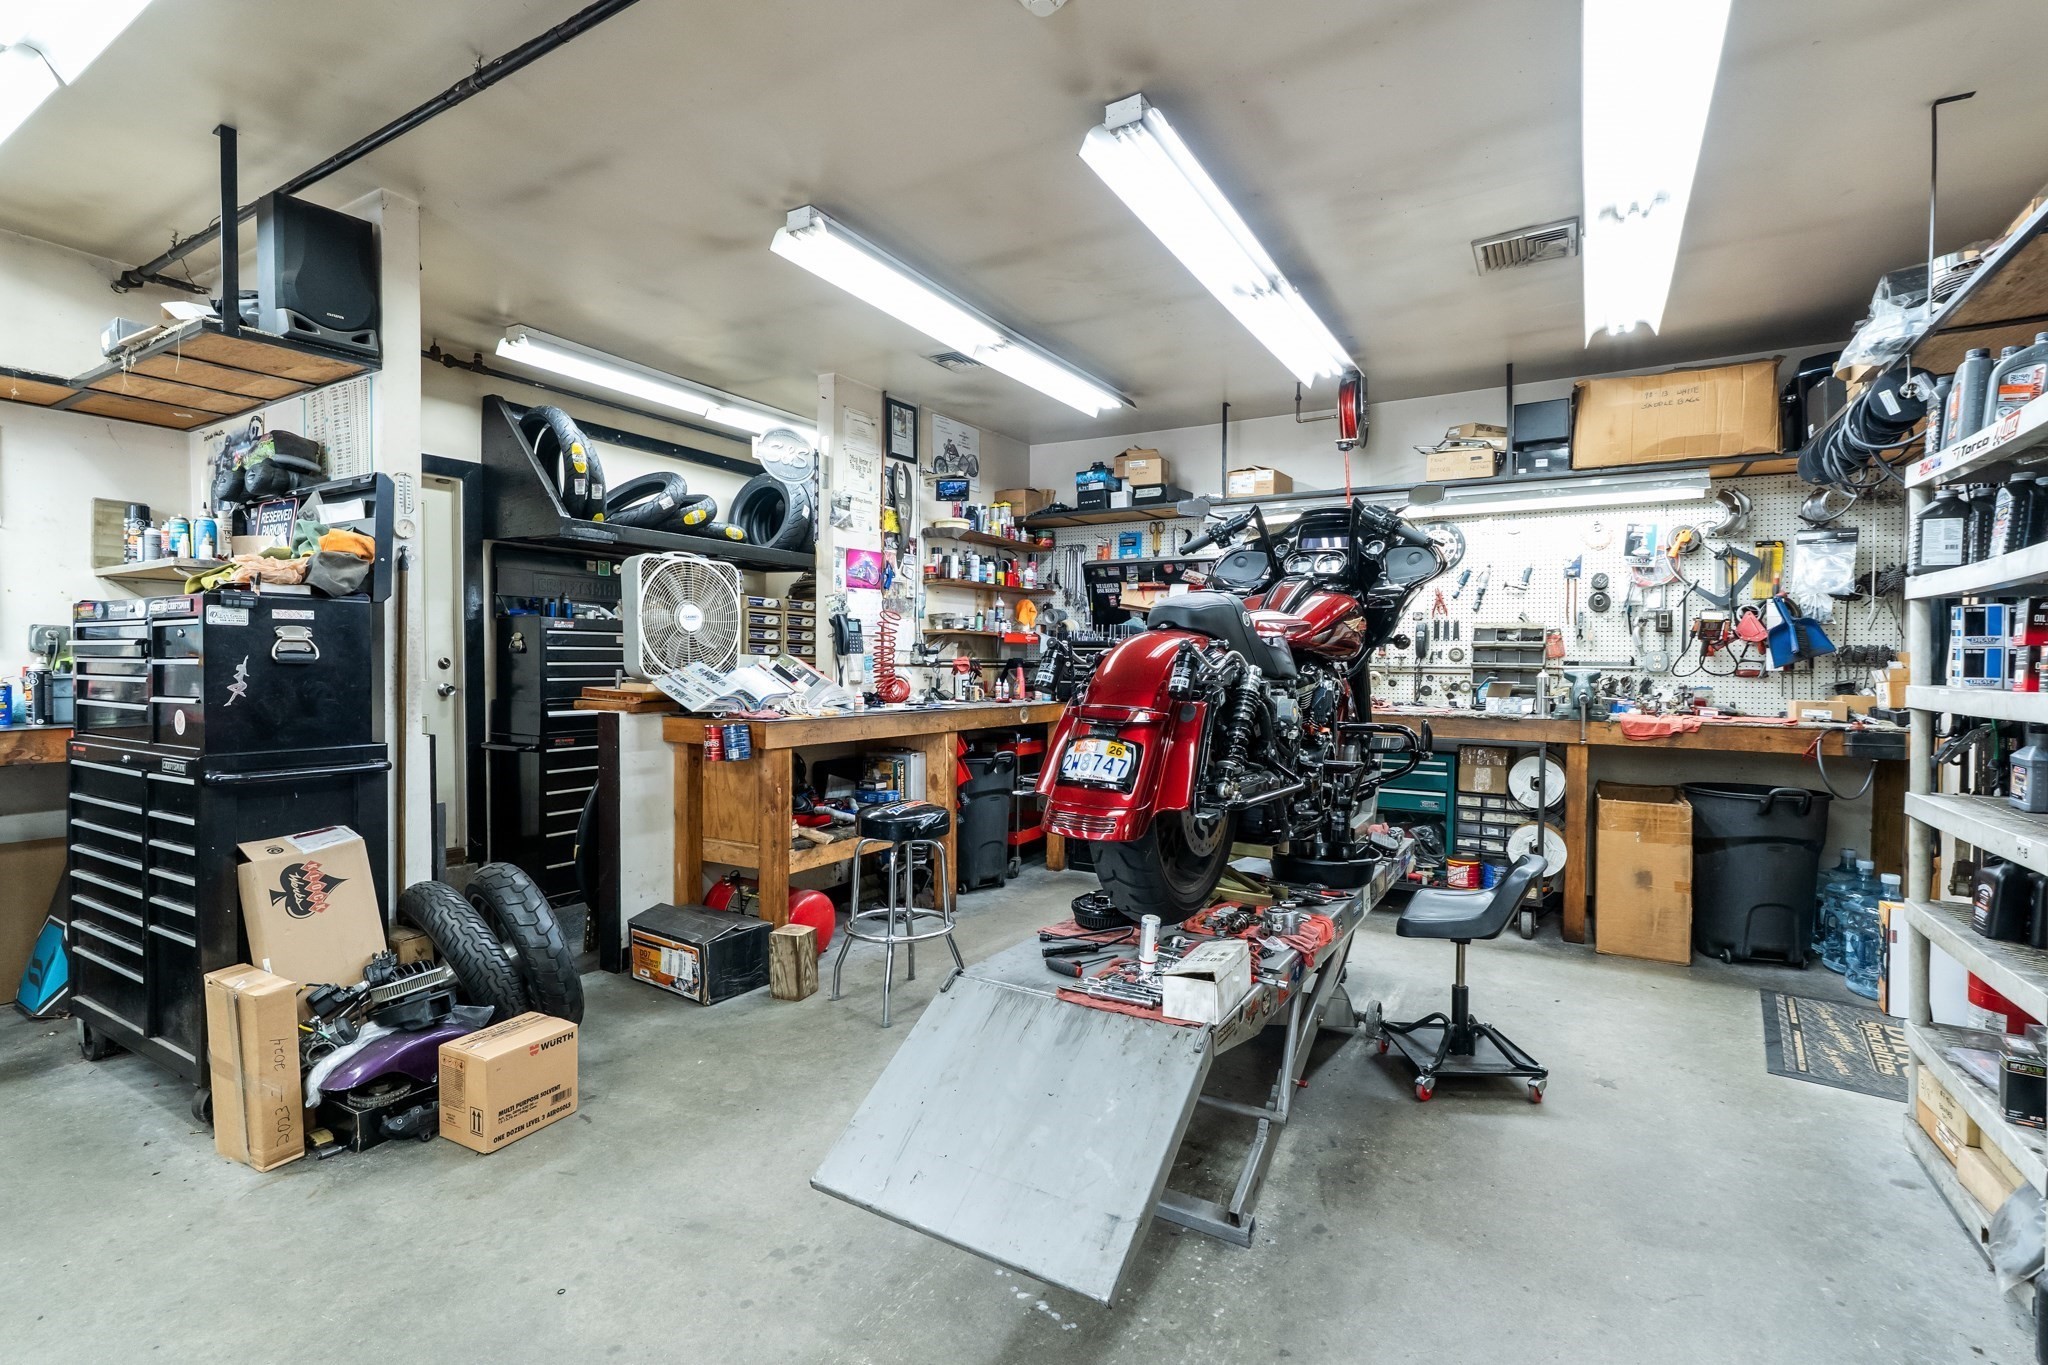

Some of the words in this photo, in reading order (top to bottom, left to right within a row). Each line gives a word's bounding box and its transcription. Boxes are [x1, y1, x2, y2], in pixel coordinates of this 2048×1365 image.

[1676, 386, 1699, 396] WHITE
[1640, 400, 1673, 409] SADDLE
[1961, 436, 1990, 457] Torco
[260, 508, 293, 524] RESERVED
[261, 522, 288, 536] PARKING
[2034, 614, 2046, 622] OIL
[1108, 746, 1123, 756] 26
[304, 861, 328, 912] KLOCK
[540, 1031, 574, 1051] WÜRTH
[1859, 1020, 1899, 1076] Specialties
[498, 1105, 515, 1117] MULTI
[515, 1094, 539, 1109] PURPOSE
[540, 1084, 561, 1098] SOLVENT
[493, 1134, 505, 1144] ONE
[506, 1124, 525, 1138] DOZEN
[525, 1117, 541, 1128] LEVEL
[546, 1102, 571, 1118] AEROSOLS
